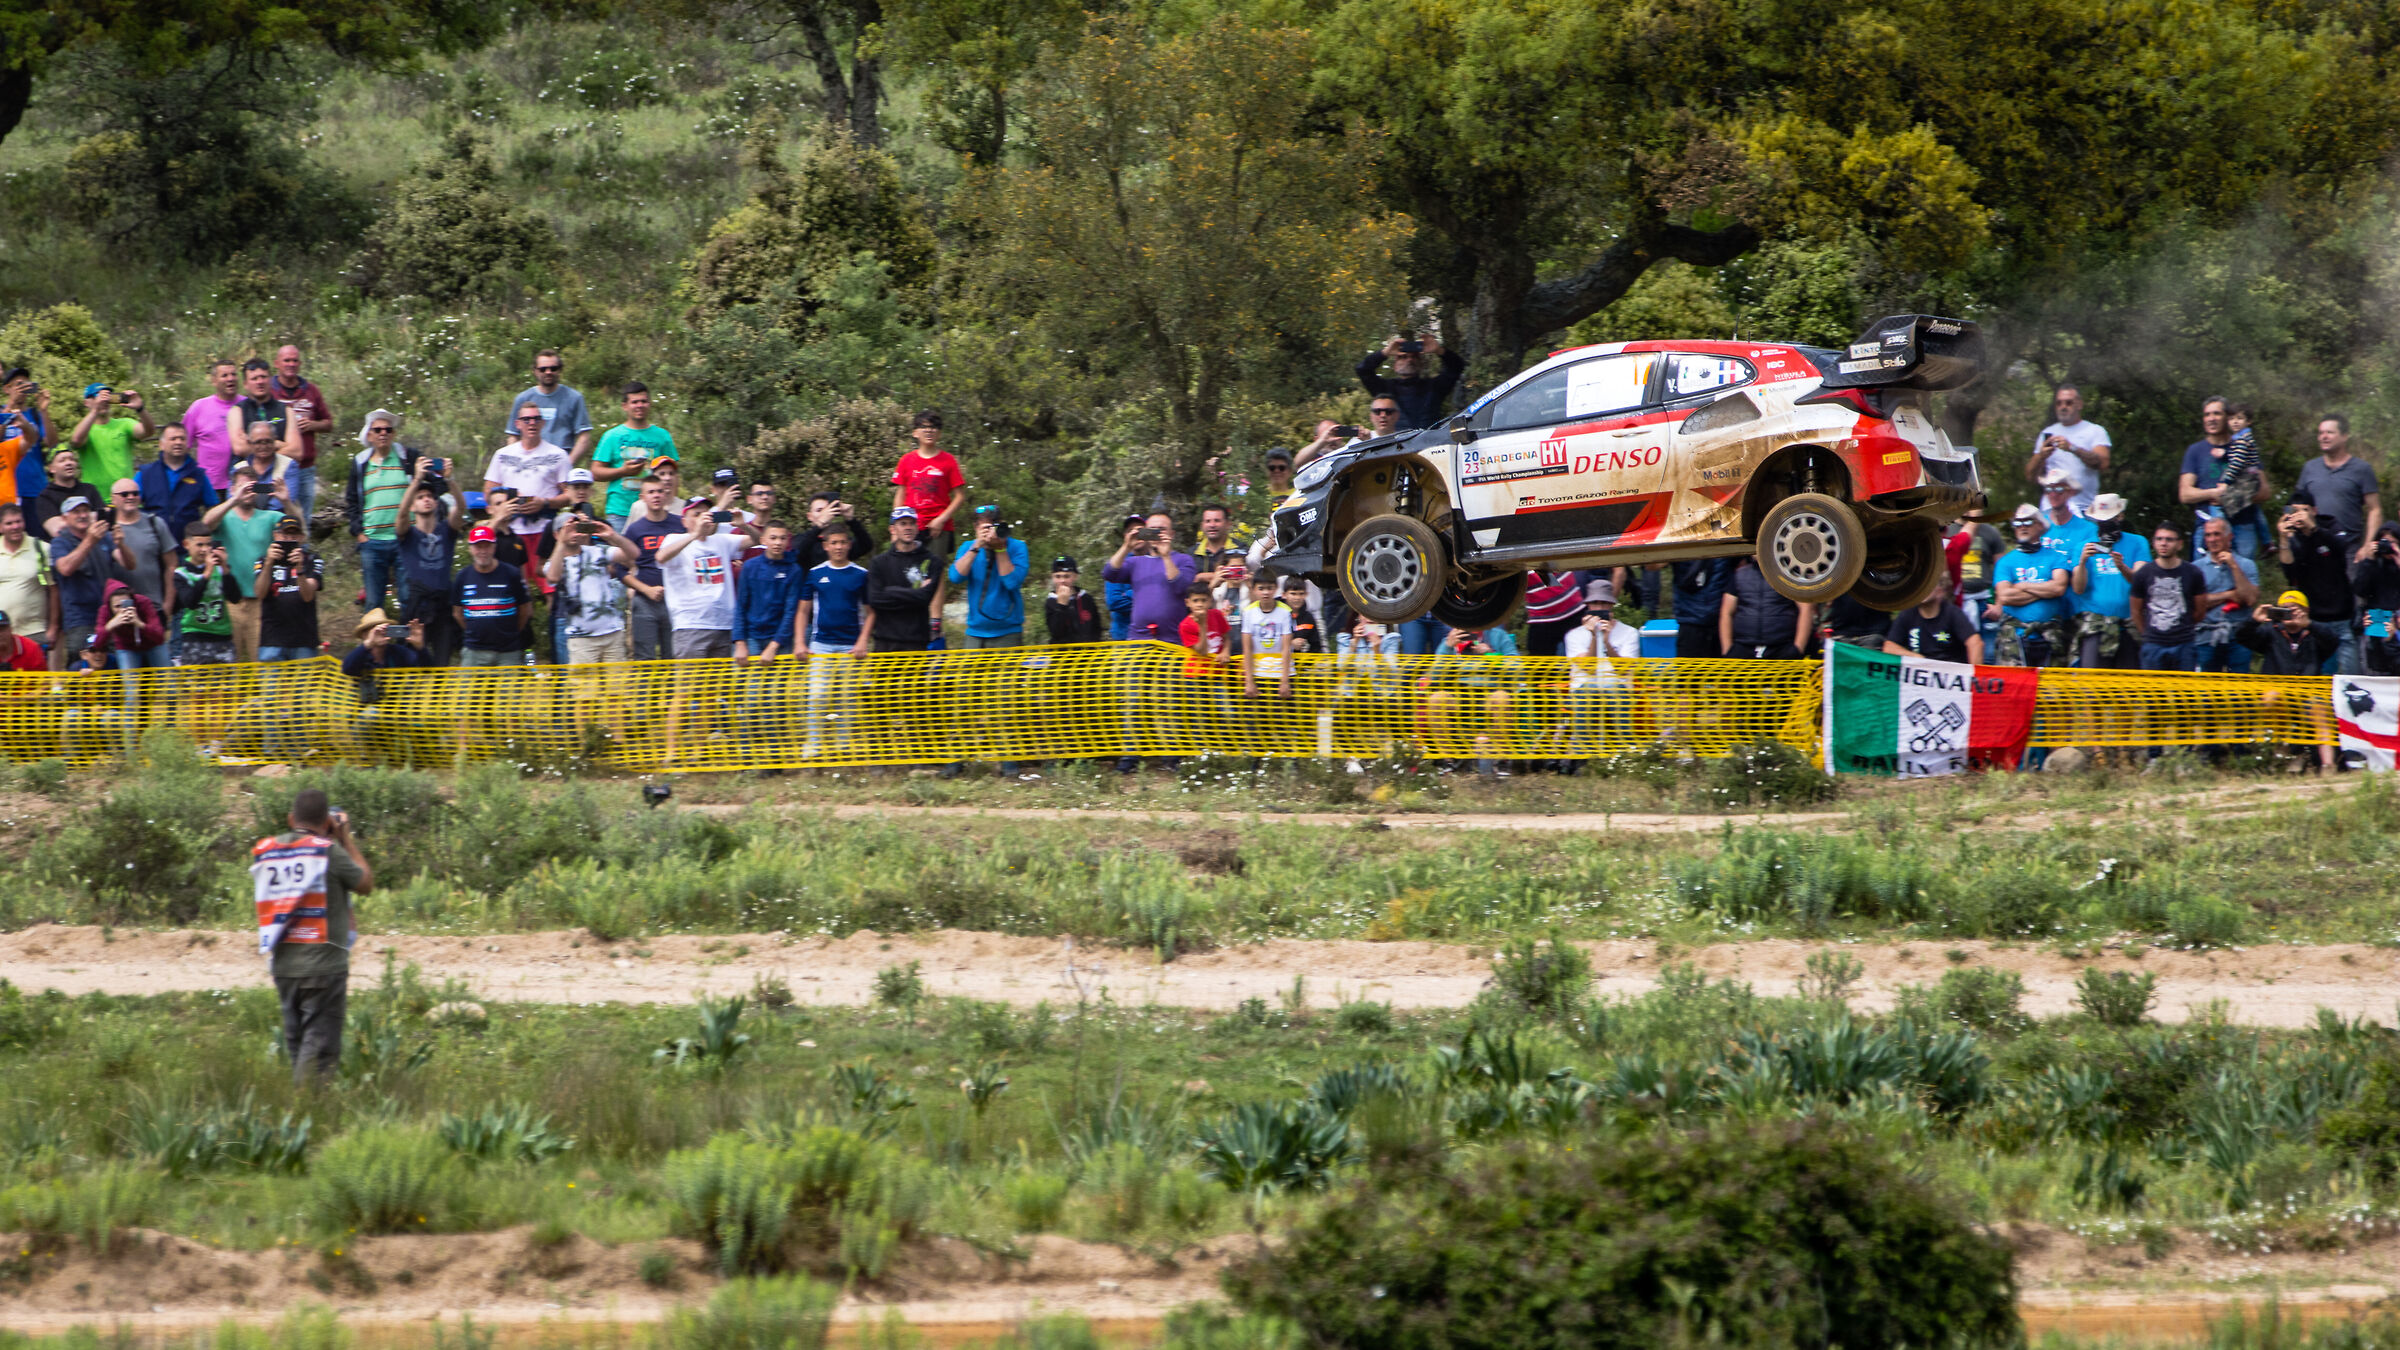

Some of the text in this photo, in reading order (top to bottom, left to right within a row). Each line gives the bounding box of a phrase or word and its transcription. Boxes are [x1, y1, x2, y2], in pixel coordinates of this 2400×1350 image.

[1464, 450, 1480, 463] 20
[1480, 450, 1538, 465] SARDEGNA
[1573, 446, 1662, 475] DENSO
[1464, 462, 1480, 474] 23
[1512, 469, 1544, 479] Championship
[1703, 468, 1730, 480] Mobil
[1299, 510, 1317, 523] OMP
[1867, 661, 2005, 695] PRIGNANO
